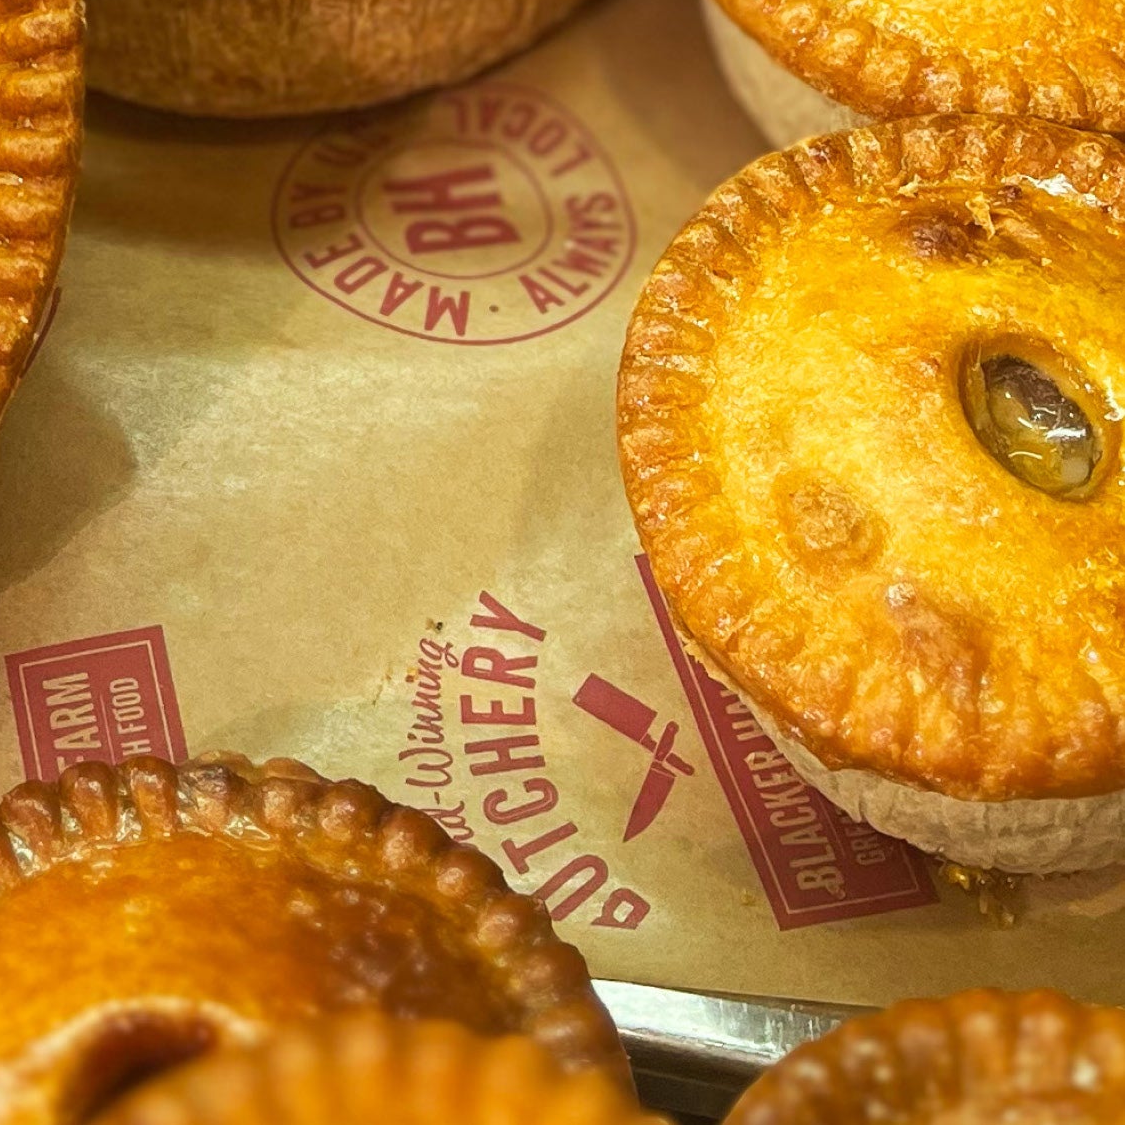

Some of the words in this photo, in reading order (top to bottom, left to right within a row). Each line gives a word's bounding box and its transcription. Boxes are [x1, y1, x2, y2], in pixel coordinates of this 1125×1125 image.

[439, 94, 596, 178] LOCAL
[289, 182, 348, 230] BY
[382, 164, 523, 255] BH
[518, 192, 623, 315] ALWAYS
[303, 232, 471, 337] MADE
[109, 677, 148, 735] FOOD
[458, 590, 651, 931] BUTCHERY
[747, 751, 846, 892] BLACKER
